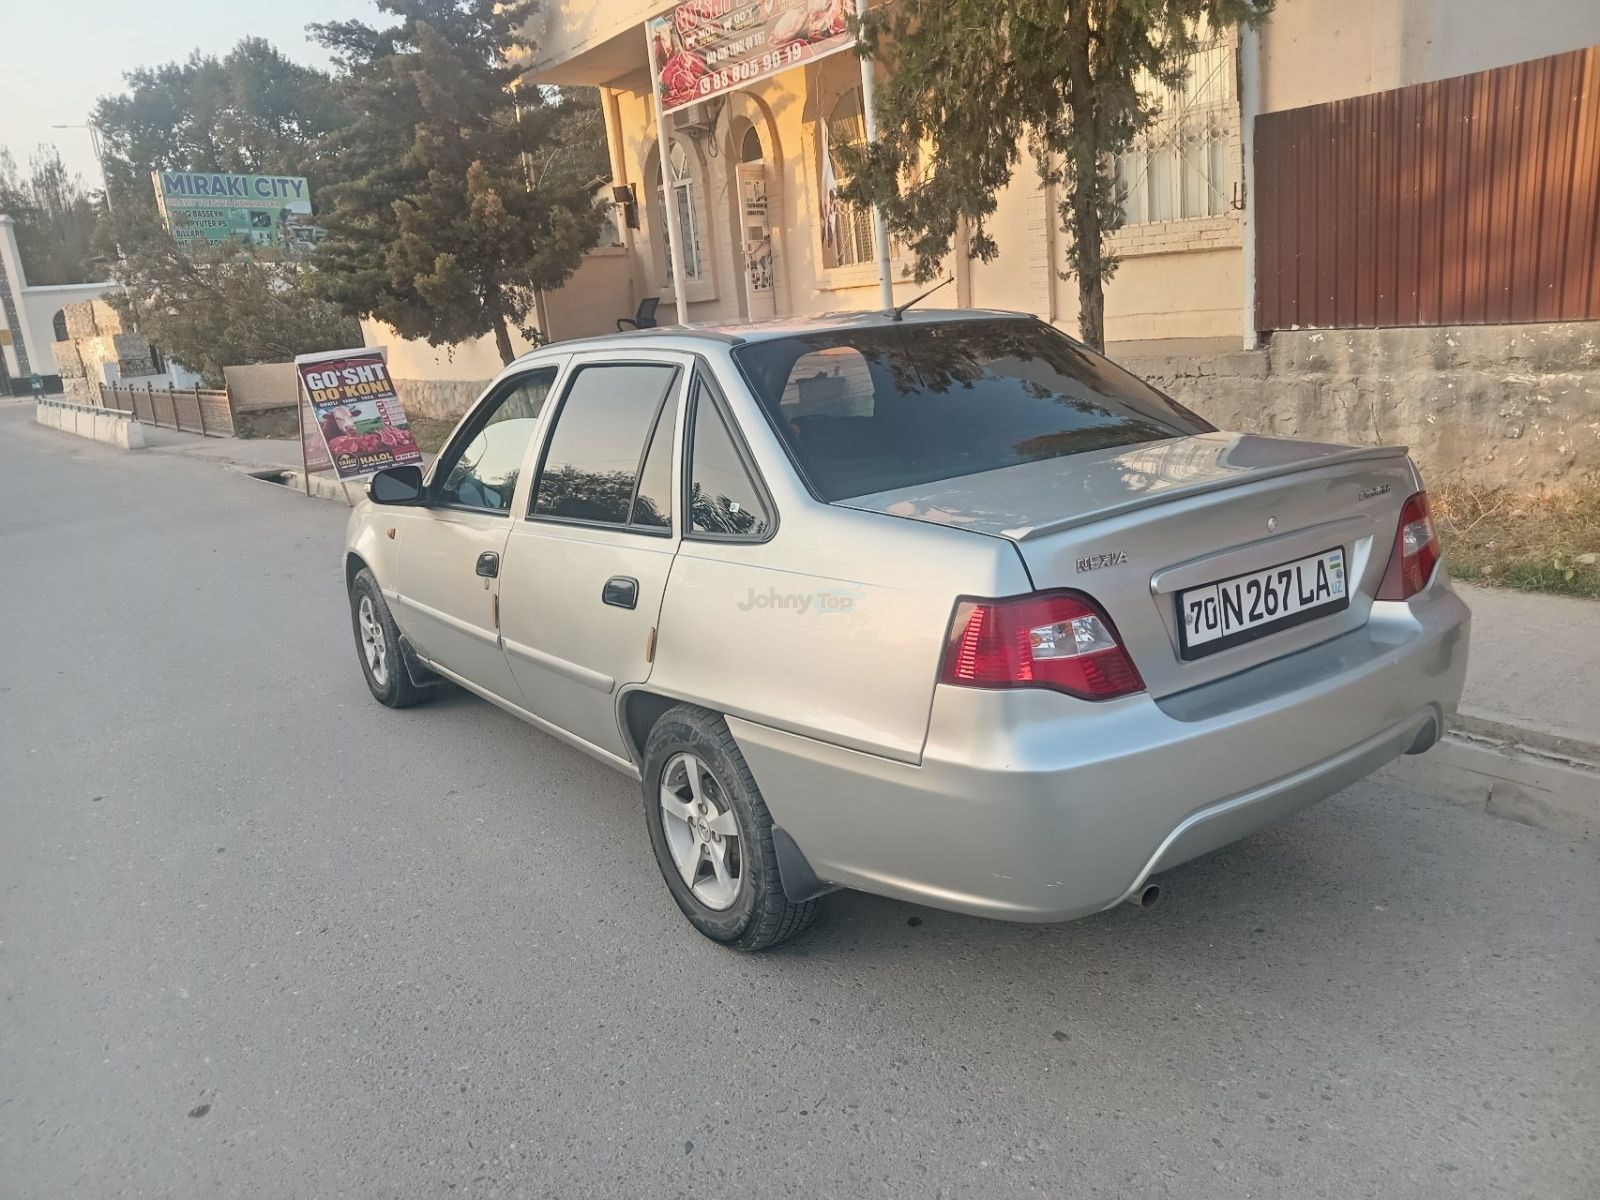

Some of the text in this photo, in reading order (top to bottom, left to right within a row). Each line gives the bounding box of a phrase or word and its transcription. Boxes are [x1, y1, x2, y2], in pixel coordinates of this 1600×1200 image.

[713, 70, 729, 90] 88
[163, 174, 304, 198] MIRAKI CITY
[306, 363, 385, 391] GO'SHT
[312, 380, 391, 403] DO'KONI
[360, 452, 393, 465] HALOL
[1076, 550, 1128, 574] NEXIA
[1331, 580, 1343, 594] UZ
[1190, 597, 1218, 635] 70
